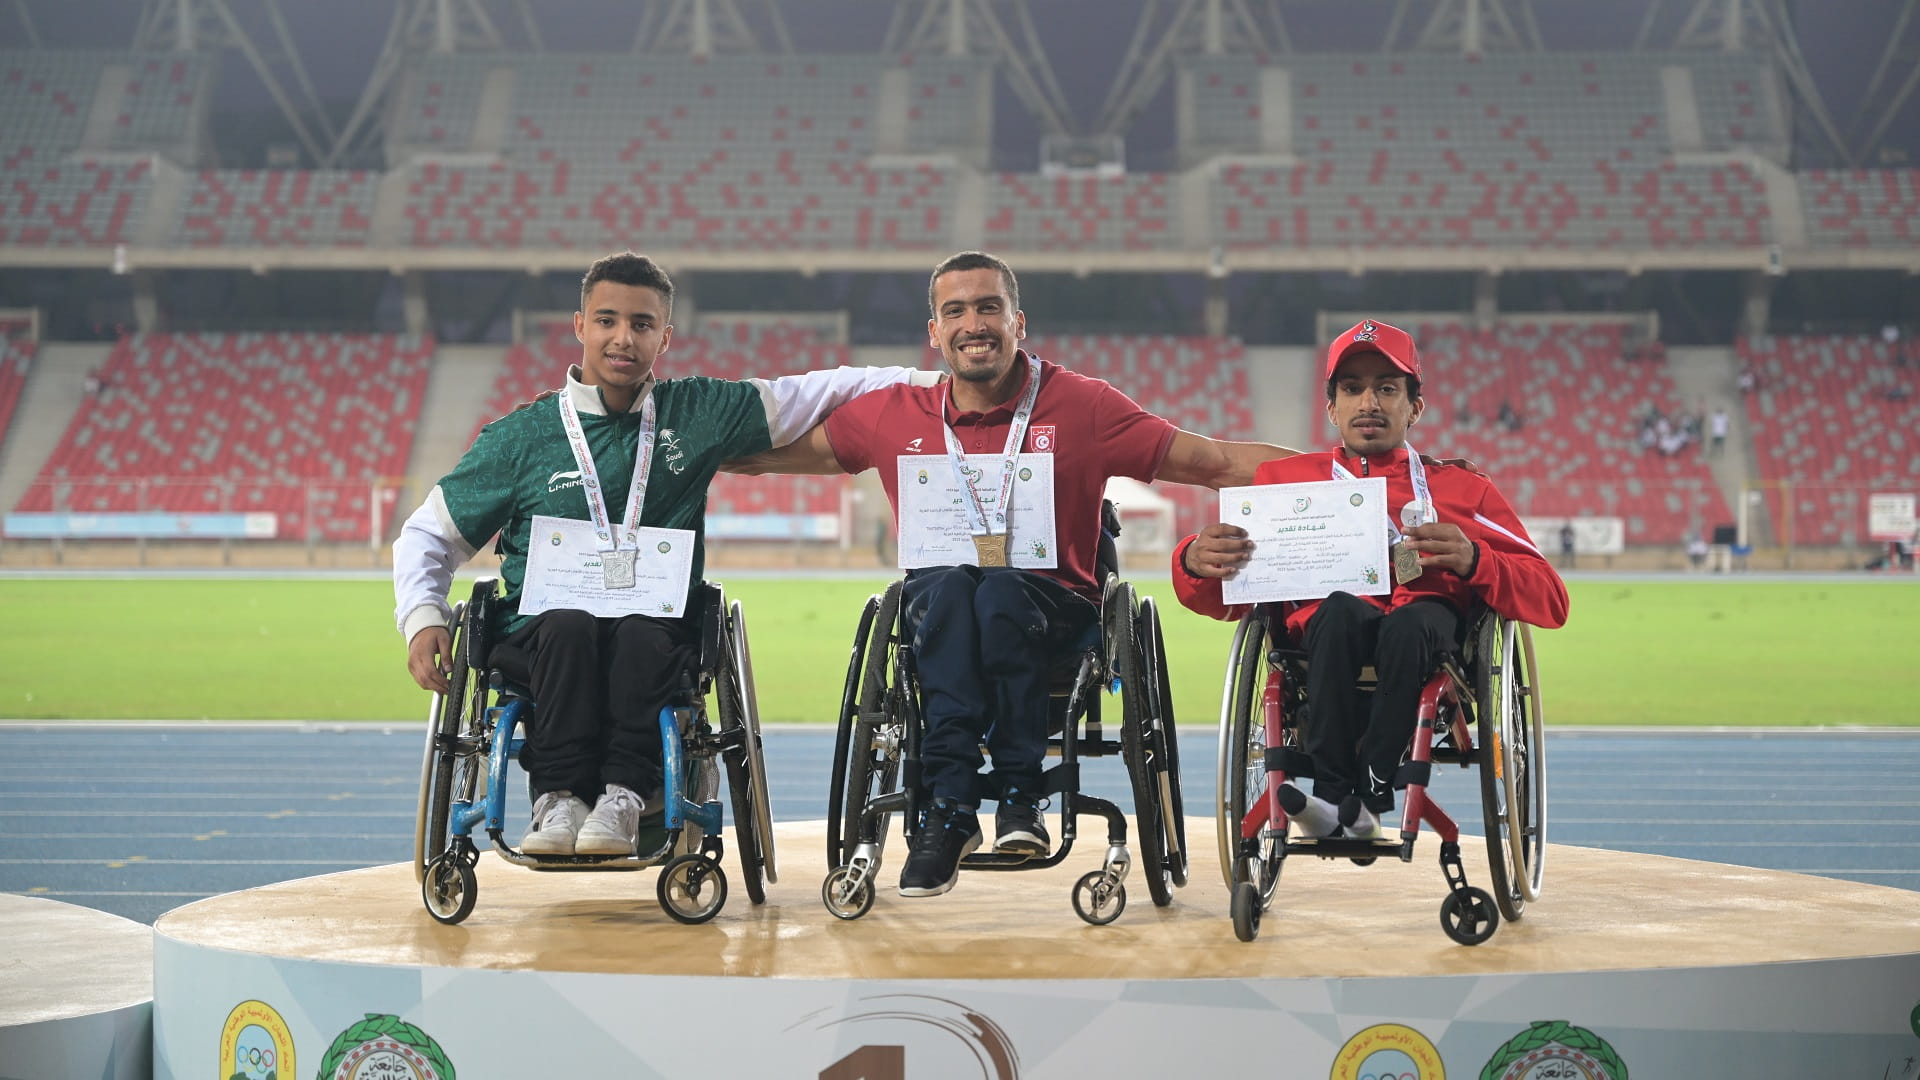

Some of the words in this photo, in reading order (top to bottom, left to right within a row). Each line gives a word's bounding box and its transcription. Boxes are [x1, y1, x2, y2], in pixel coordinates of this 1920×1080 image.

[1032, 426, 1053, 436] تونس
[665, 450, 684, 462] Saudi
[1277, 524, 1297, 534] تقدير
